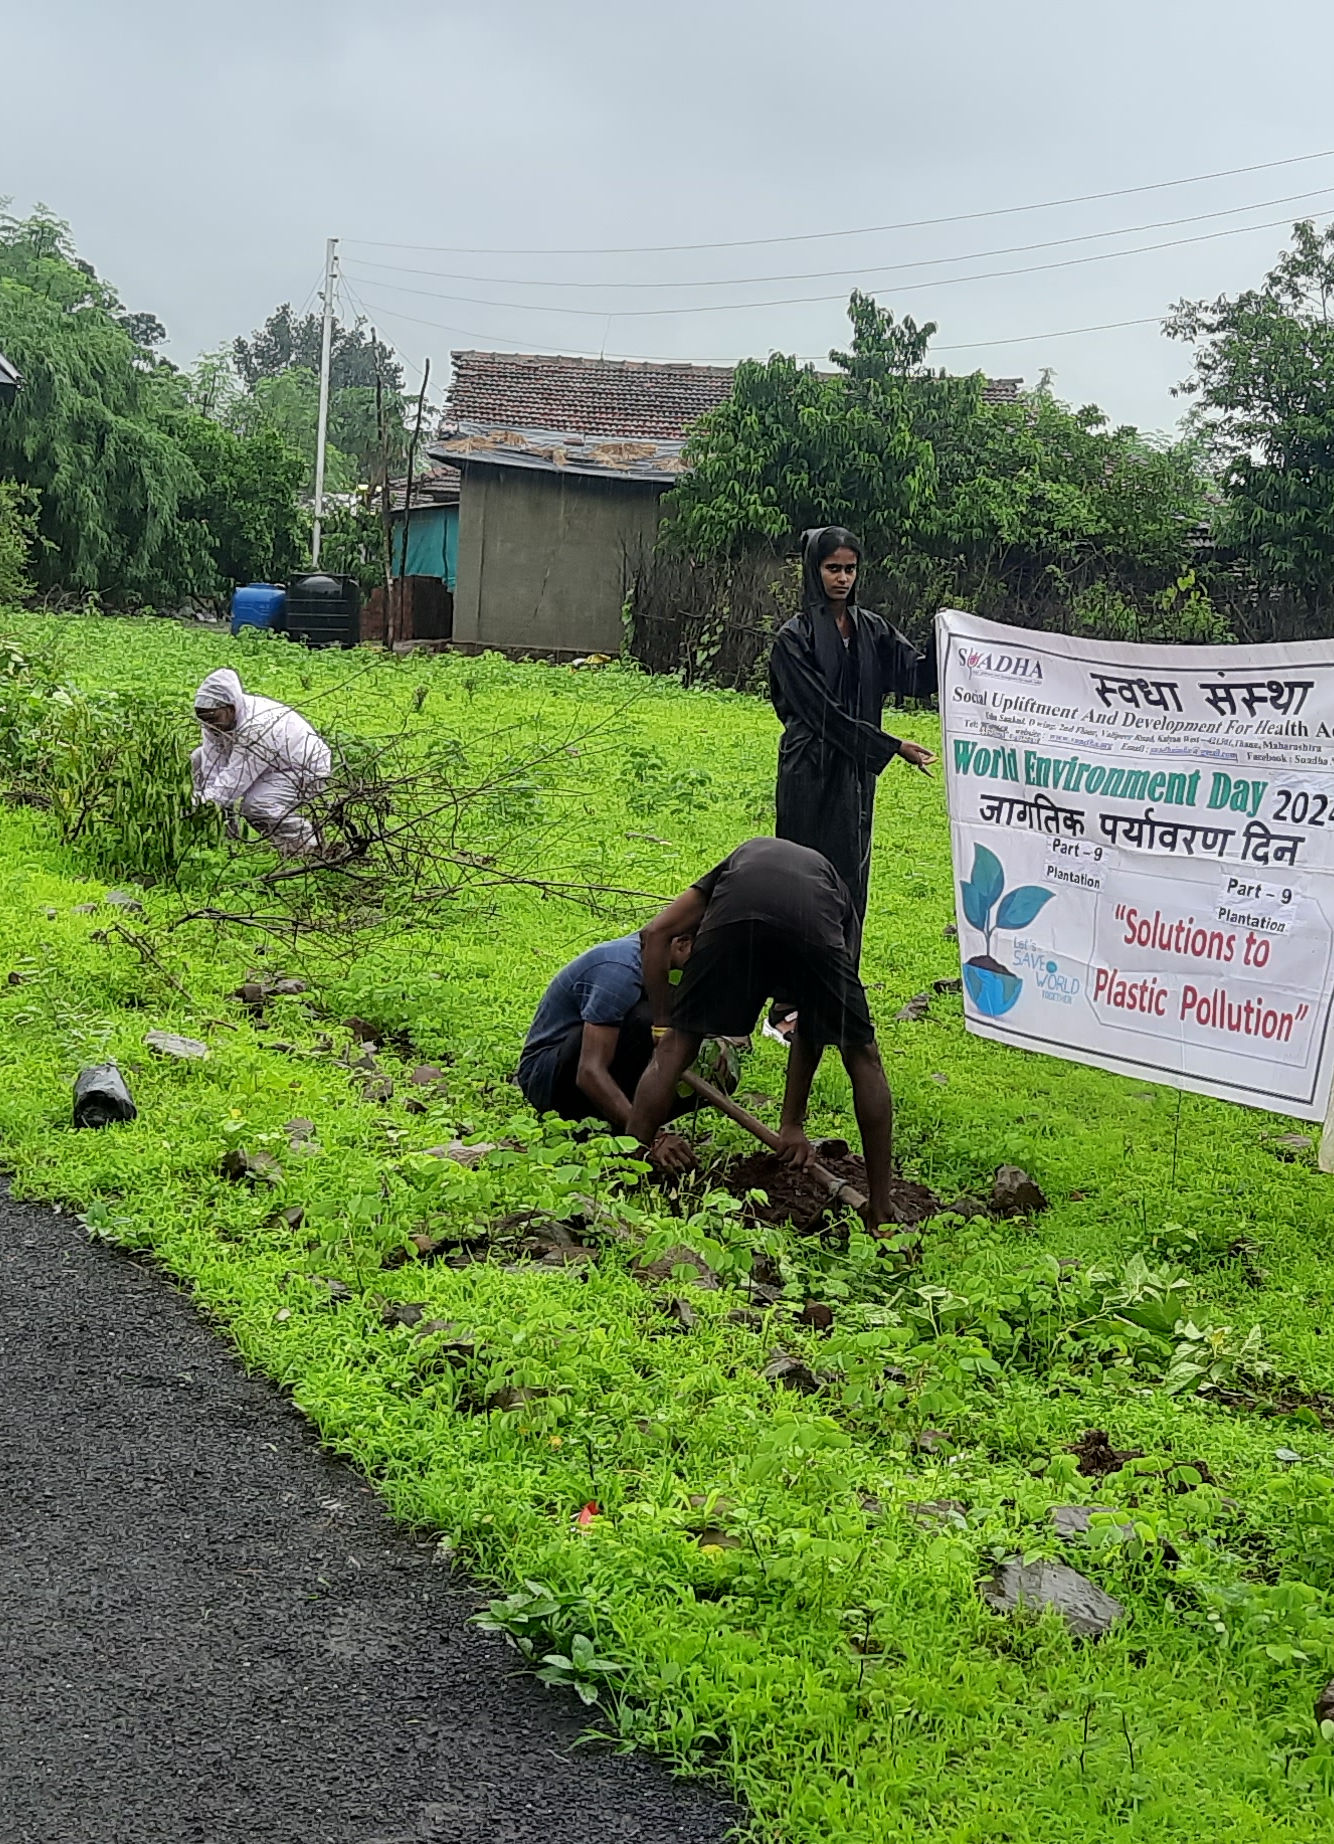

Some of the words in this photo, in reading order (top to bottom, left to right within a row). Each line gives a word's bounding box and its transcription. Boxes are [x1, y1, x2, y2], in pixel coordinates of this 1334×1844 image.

[952, 687, 987, 706] Social
[992, 692, 1080, 719] Upliftment
[1080, 708, 1118, 726] And
[1122, 711, 1223, 734] Development
[1224, 720, 1254, 735] For
[1254, 719, 1309, 737] Health
[1090, 673, 1184, 712] स्वधा
[1199, 671, 1315, 717] संस्था
[954, 739, 1020, 782] World
[1024, 750, 1201, 807] Environment
[1206, 771, 1269, 818] Day
[980, 793, 1085, 836] जागतिक
[1099, 808, 1236, 857] पर्यावरण
[1241, 820, 1305, 866] दिन
[1052, 838, 1080, 857] Part
[1047, 865, 1100, 889] Plantation
[1227, 877, 1262, 899] Part
[1115, 904, 1236, 962] “Solutions
[1243, 931, 1271, 967] to
[1218, 906, 1286, 932] Plantation
[1012, 950, 1046, 971] SAVE
[1036, 971, 1080, 995] WORLD
[1093, 967, 1168, 1016] Plastic
[1180, 984, 1310, 1042] Pollution”
